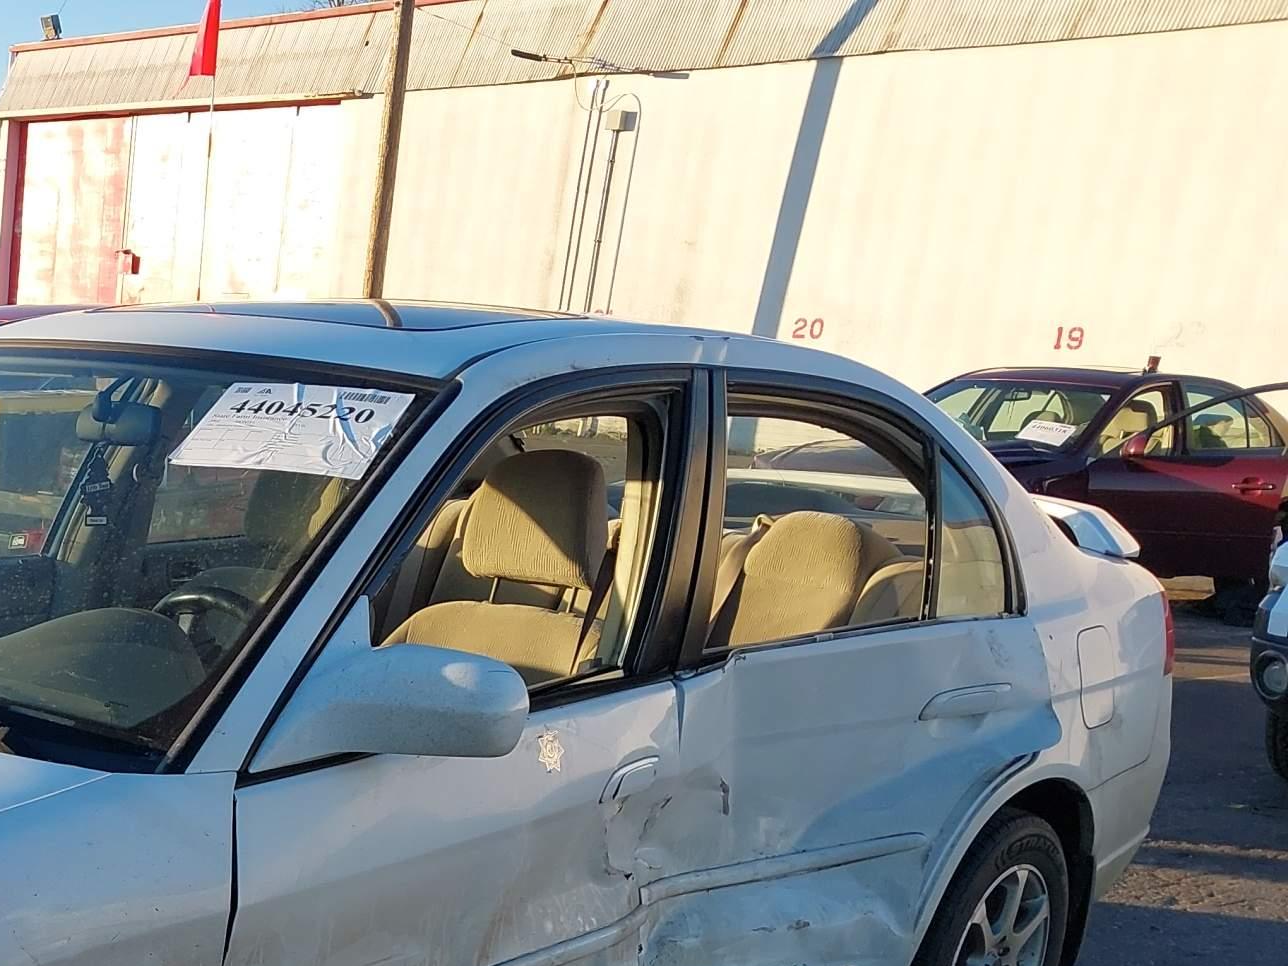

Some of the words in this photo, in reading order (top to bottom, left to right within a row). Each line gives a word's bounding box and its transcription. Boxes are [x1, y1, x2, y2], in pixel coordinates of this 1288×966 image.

[792, 318, 825, 340] 20
[1053, 326, 1085, 350] 19
[229, 399, 375, 424] 44045220
